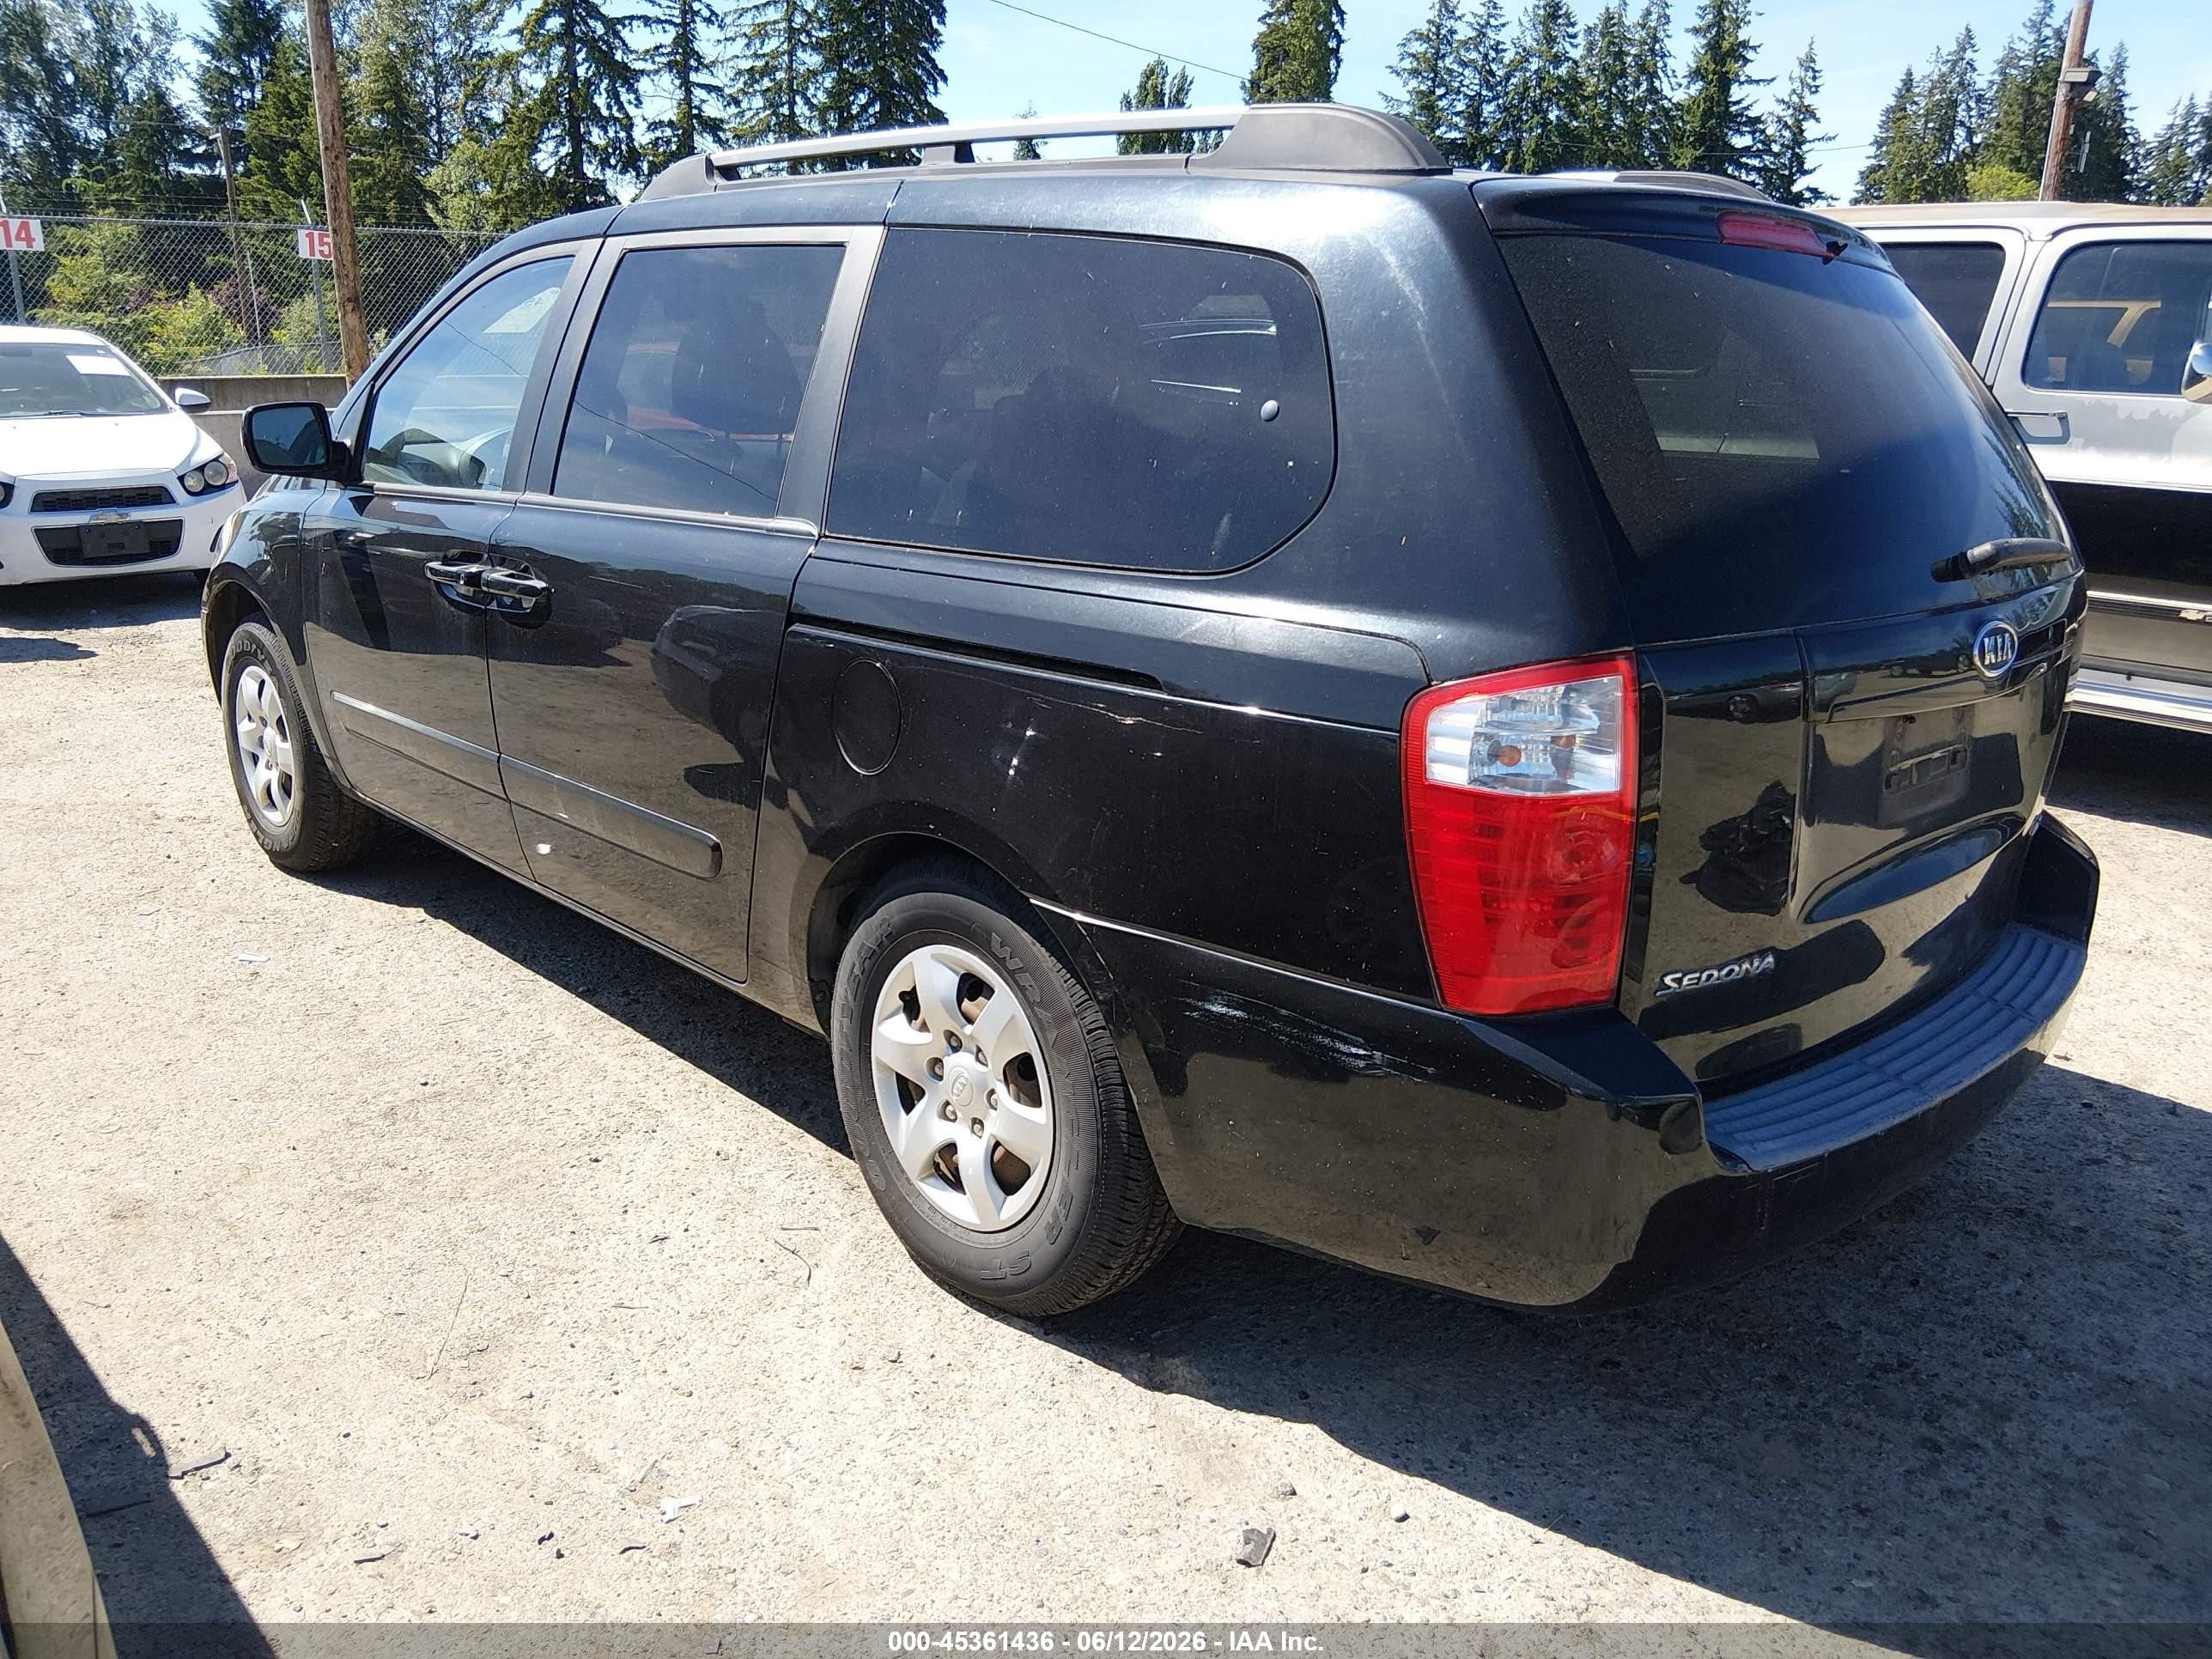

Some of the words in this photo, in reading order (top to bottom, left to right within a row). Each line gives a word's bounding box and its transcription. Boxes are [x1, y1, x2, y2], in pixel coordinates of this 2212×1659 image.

[0, 220, 35, 249] 14
[305, 231, 332, 258] 15
[1983, 633, 2012, 665] KIA
[1654, 951, 1775, 997] SEDONA
[989, 932, 1079, 1245] WRANGLER
